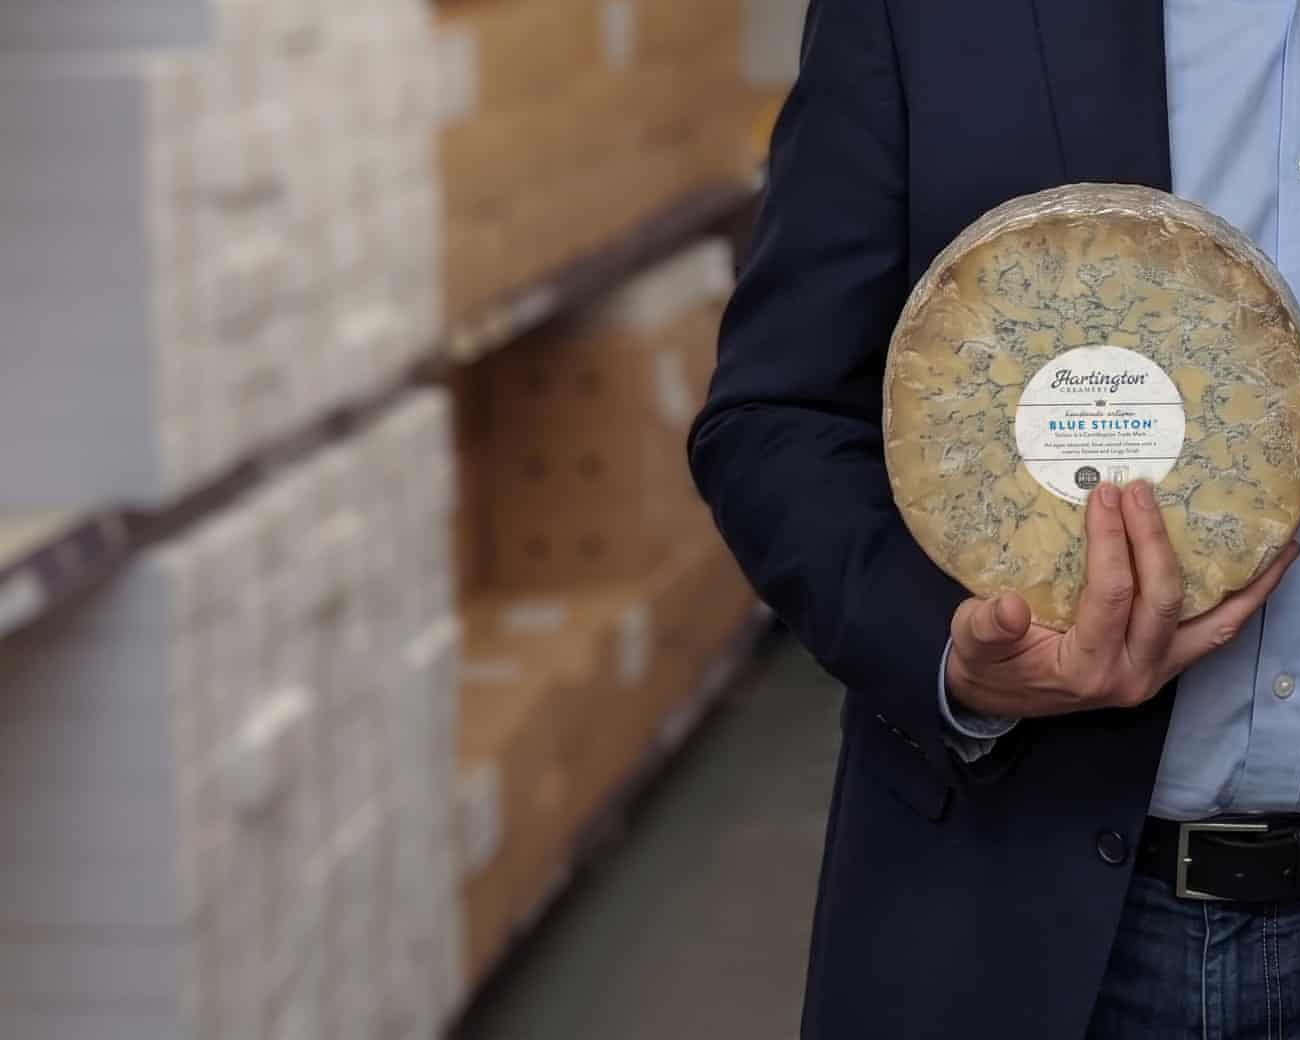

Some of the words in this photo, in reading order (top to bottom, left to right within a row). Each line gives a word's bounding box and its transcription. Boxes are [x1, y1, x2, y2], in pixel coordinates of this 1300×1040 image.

[1051, 368, 1146, 393] Hartington
[1048, 419, 1086, 431] BLUE
[1091, 418, 1152, 430] STILTON
